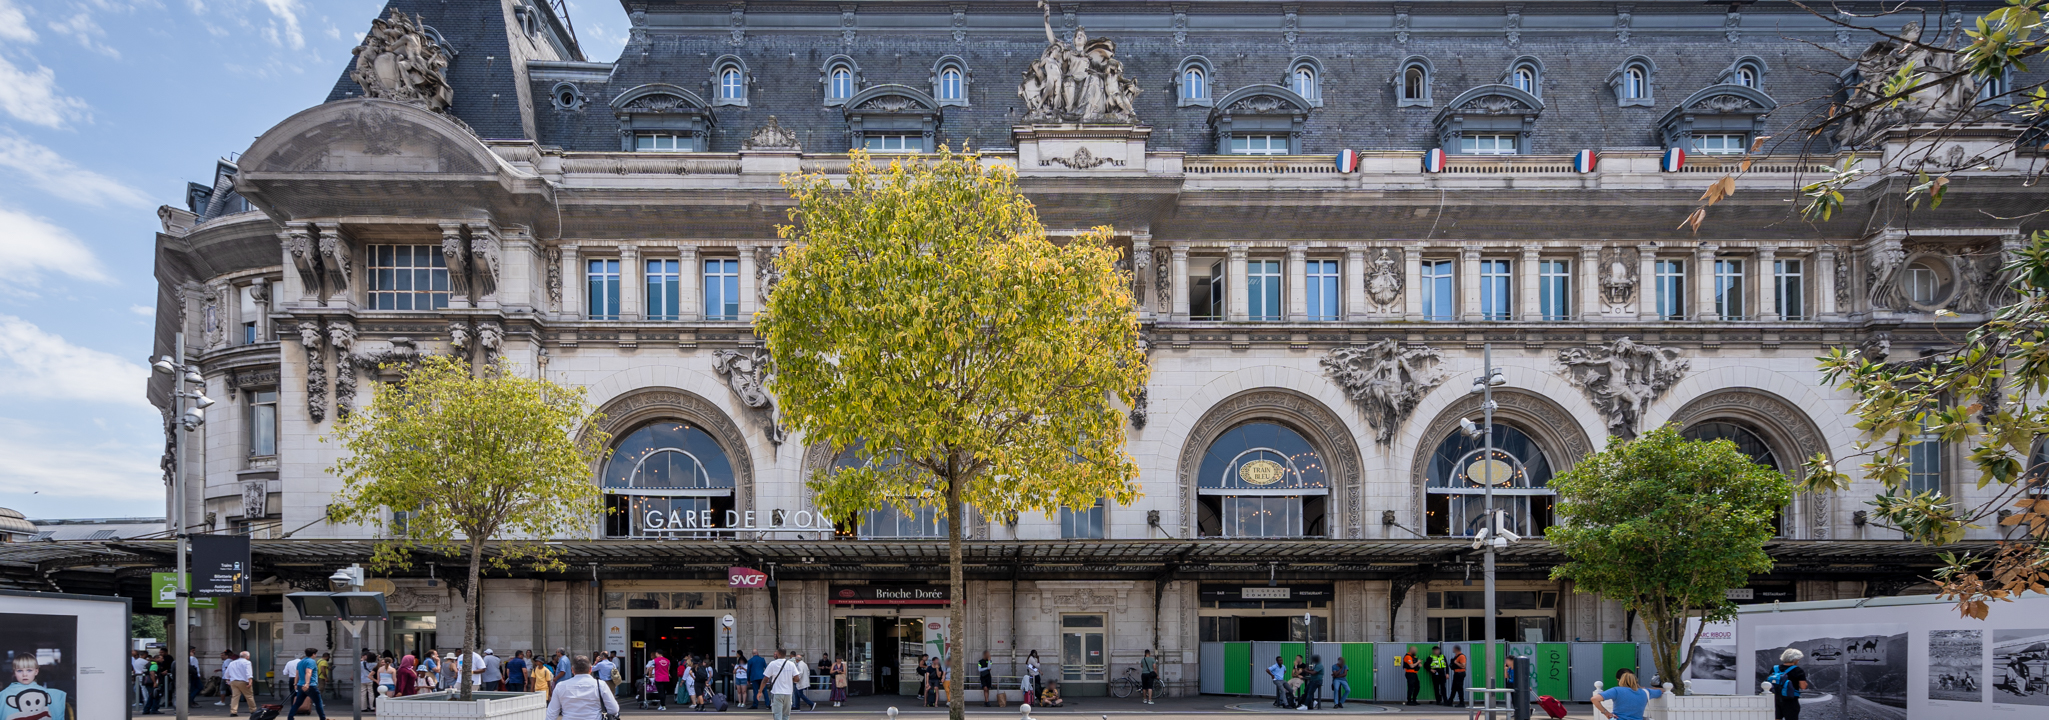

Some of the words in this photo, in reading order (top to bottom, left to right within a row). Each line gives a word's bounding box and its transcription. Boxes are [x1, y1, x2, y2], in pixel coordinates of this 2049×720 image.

[646, 510, 712, 528] GARE
[726, 510, 755, 528] DE
[768, 510, 834, 528] LYON
[730, 575, 764, 585] SNCF
[876, 589, 912, 598] Brioche
[915, 589, 942, 598] Dorée
